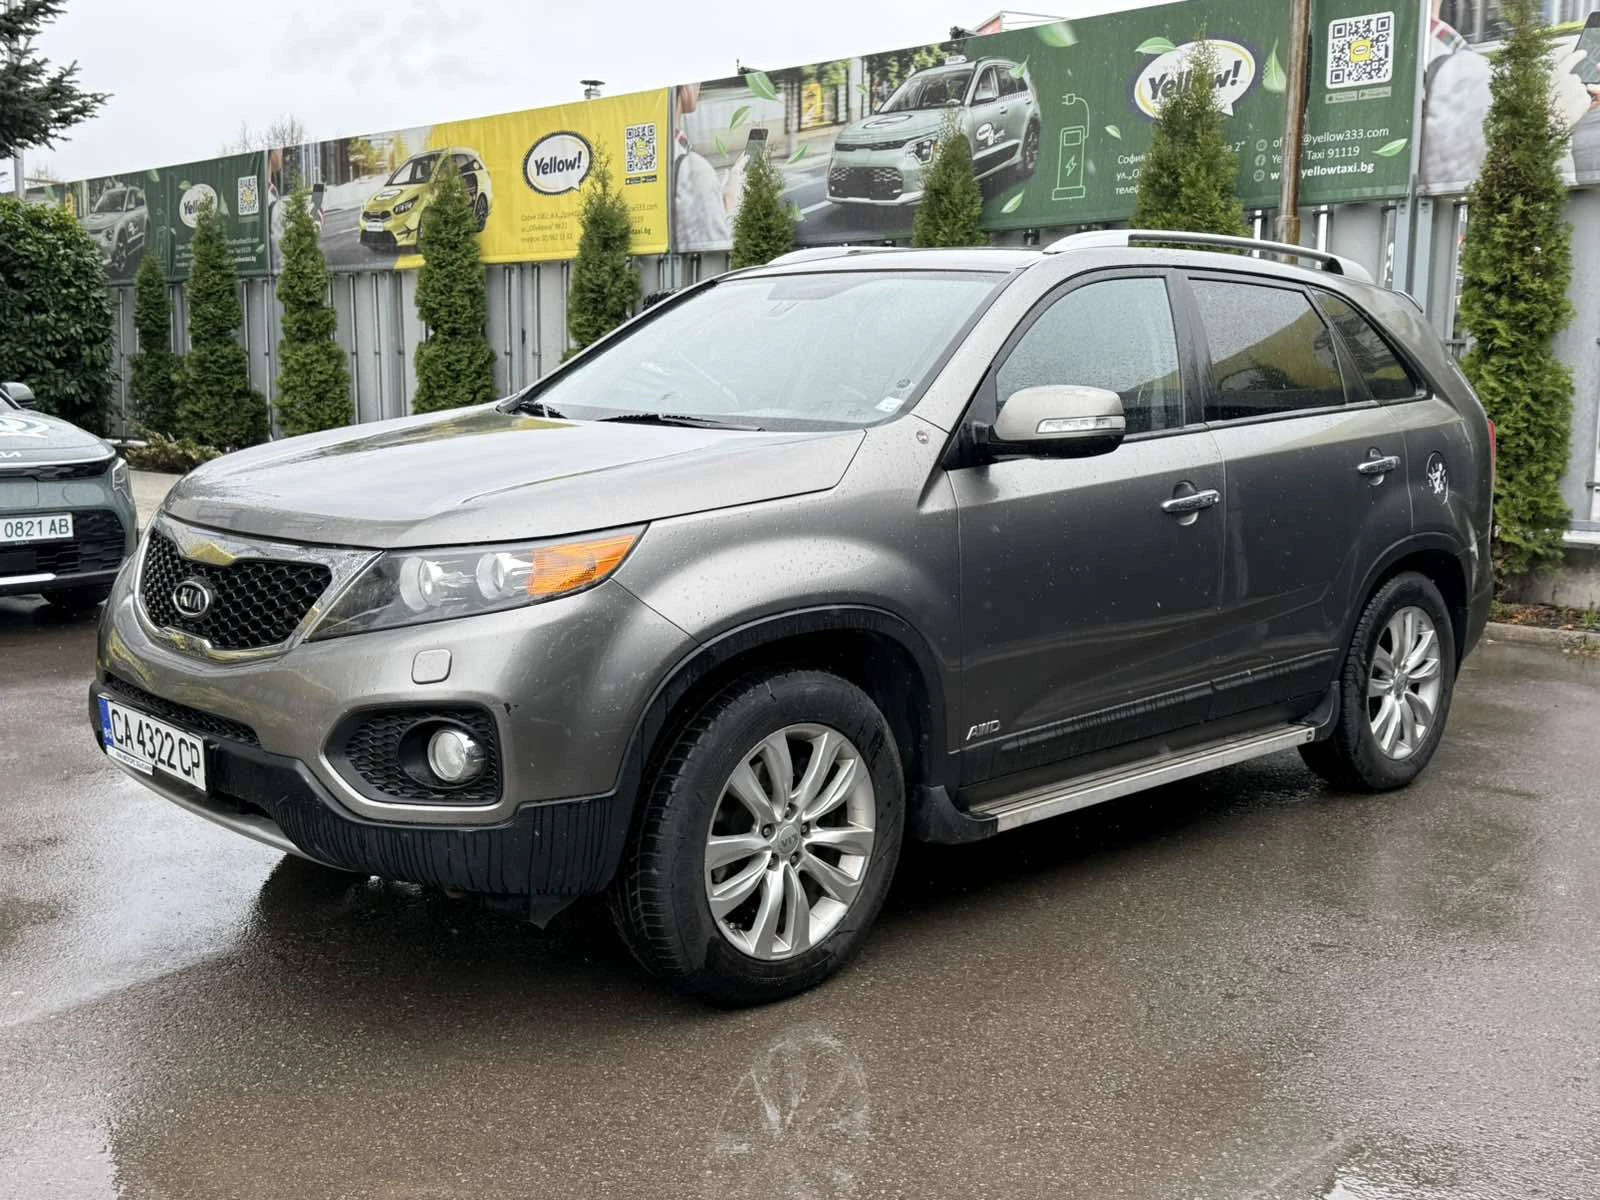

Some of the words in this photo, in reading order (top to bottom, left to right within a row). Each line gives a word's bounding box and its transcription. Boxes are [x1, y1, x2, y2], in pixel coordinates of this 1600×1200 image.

[1148, 60, 1242, 100] Yellw!
[1272, 128, 1389, 148] of@yellow333.com
[534, 150, 582, 176] Yellow!
[1307, 150, 1325, 160] Taxi
[1327, 146, 1360, 158] 91119
[1270, 162, 1375, 180] wyellowtaxi.bg
[4, 520, 43, 538] 0821
[48, 518, 70, 536] AB
[966, 719, 1000, 741] AWD
[111, 708, 135, 751] CA
[137, 719, 177, 771] 4322
[178, 737, 201, 780] CP
